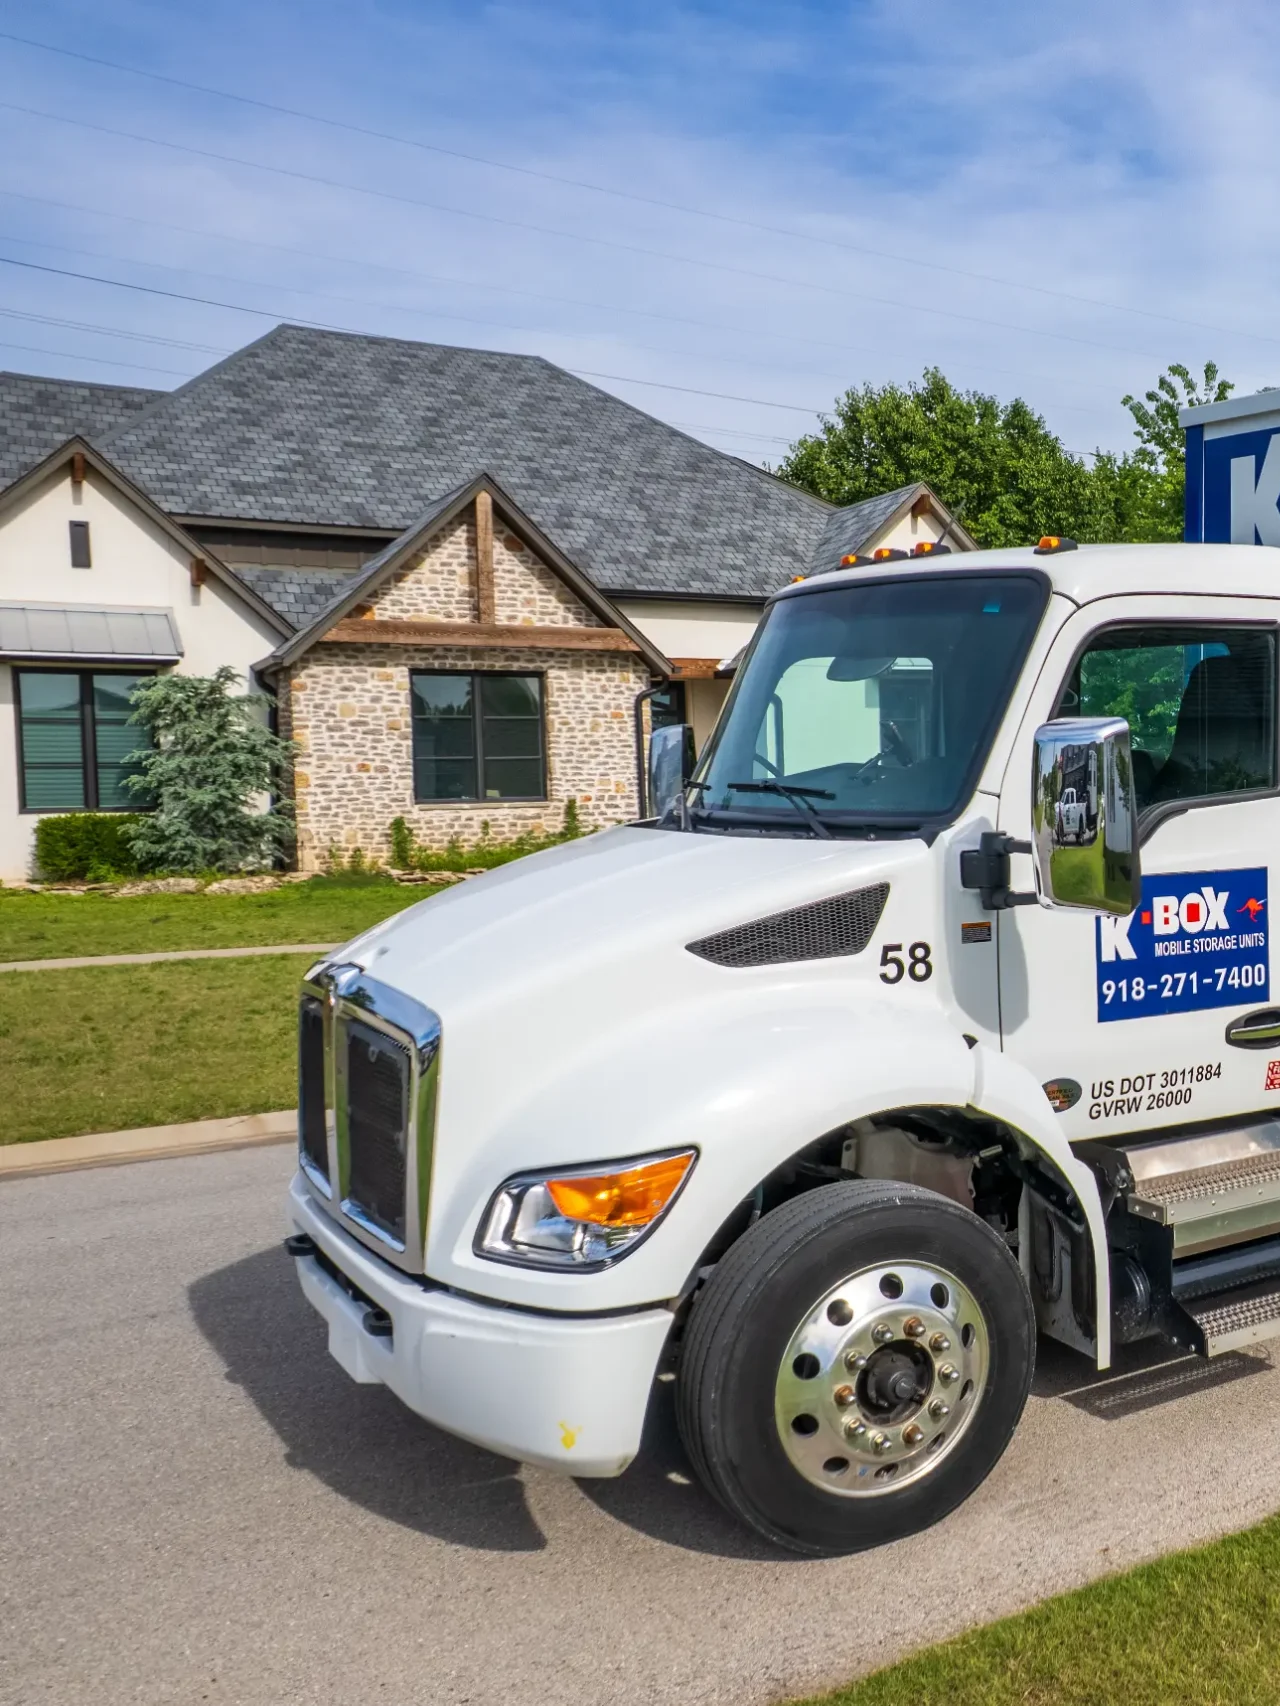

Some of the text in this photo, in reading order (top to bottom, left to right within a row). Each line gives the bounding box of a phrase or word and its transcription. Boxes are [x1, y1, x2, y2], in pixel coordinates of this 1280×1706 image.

[879, 940, 933, 985] 58
[1154, 932, 1265, 958] MOBILE STORAGE UNITS
[1102, 963, 1266, 1005] 918-271-7400
[1091, 1062, 1222, 1100] US DOT 3011884
[1088, 1087, 1192, 1120] GVRW 26000
